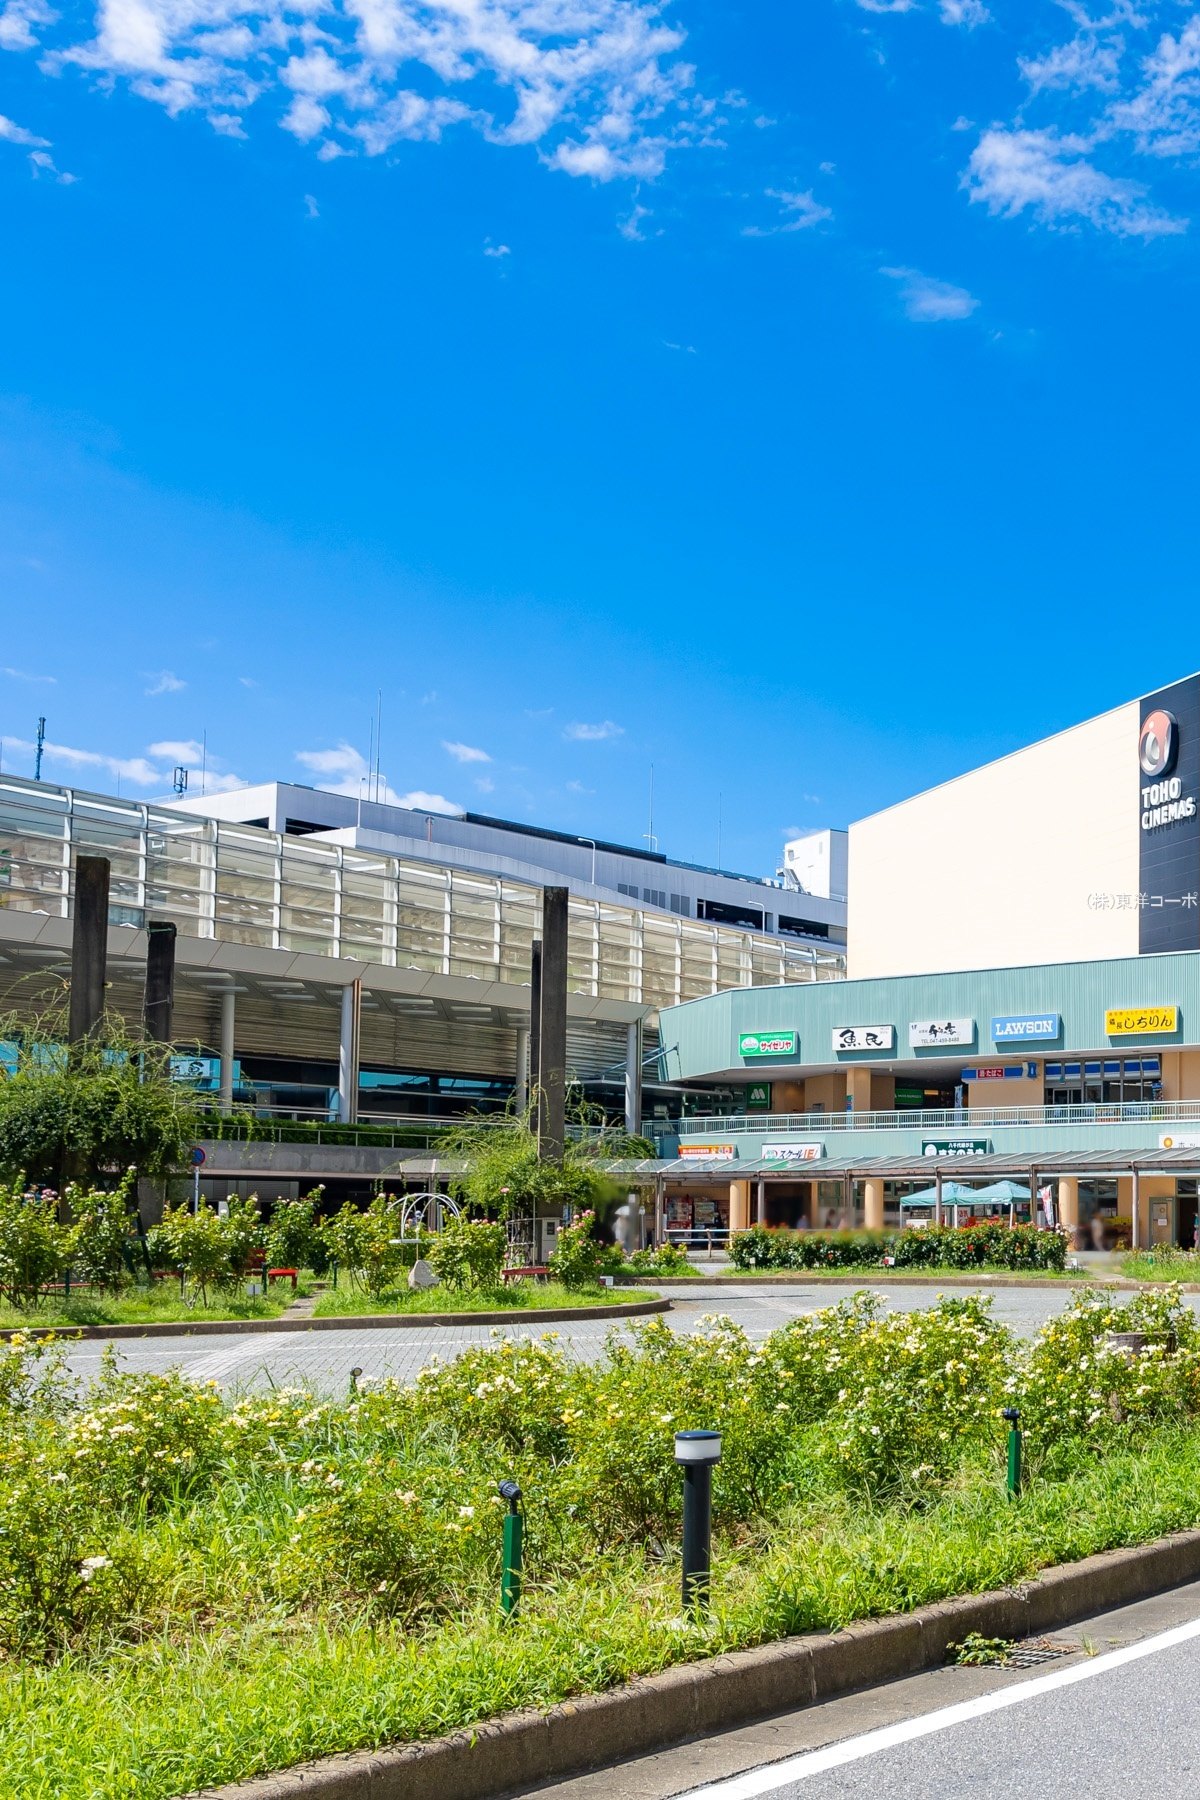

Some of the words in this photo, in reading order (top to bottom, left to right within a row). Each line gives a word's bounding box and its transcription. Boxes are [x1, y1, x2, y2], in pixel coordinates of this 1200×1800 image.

[1141, 777, 1182, 808] TOHO
[1141, 797, 1196, 830] CINEMAS
[995, 1020, 1053, 1036] LAWSON
[760, 1040, 793, 1051] サイゼリヤ
[839, 1029, 884, 1048] 魚民
